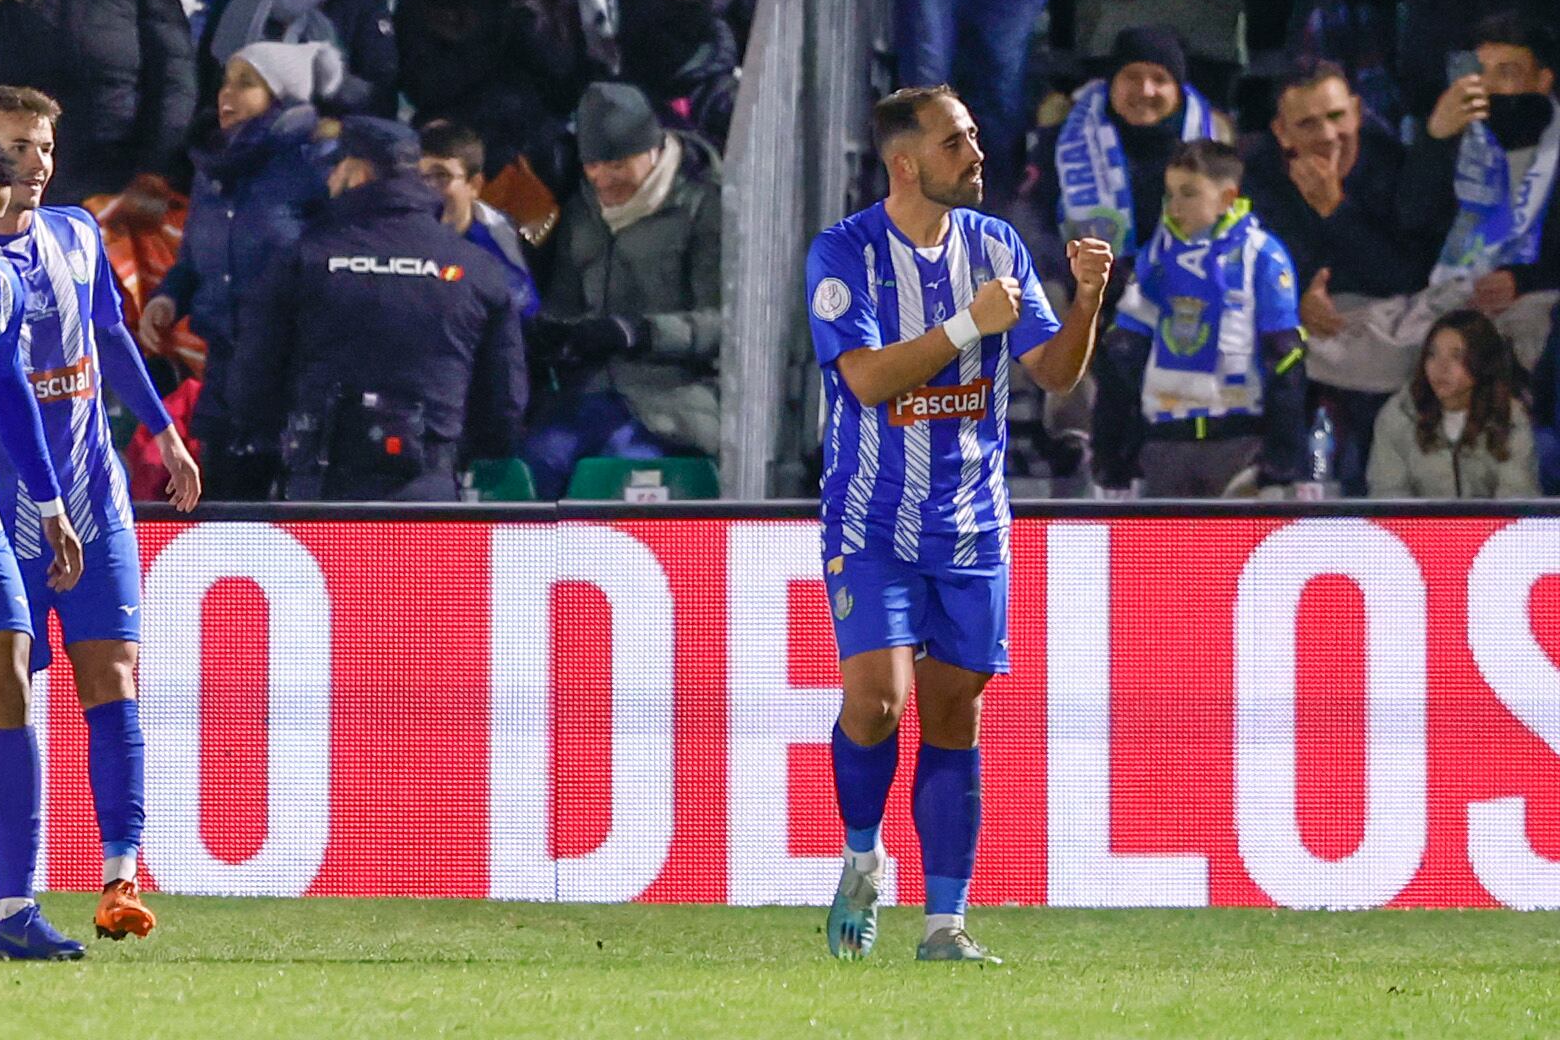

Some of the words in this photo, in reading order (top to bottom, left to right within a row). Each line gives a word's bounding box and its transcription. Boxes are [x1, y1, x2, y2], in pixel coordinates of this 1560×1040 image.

[329, 257, 440, 277] POLICIA
[34, 363, 91, 399] scual
[895, 385, 986, 416] Pascual
[487, 520, 899, 907] DE
